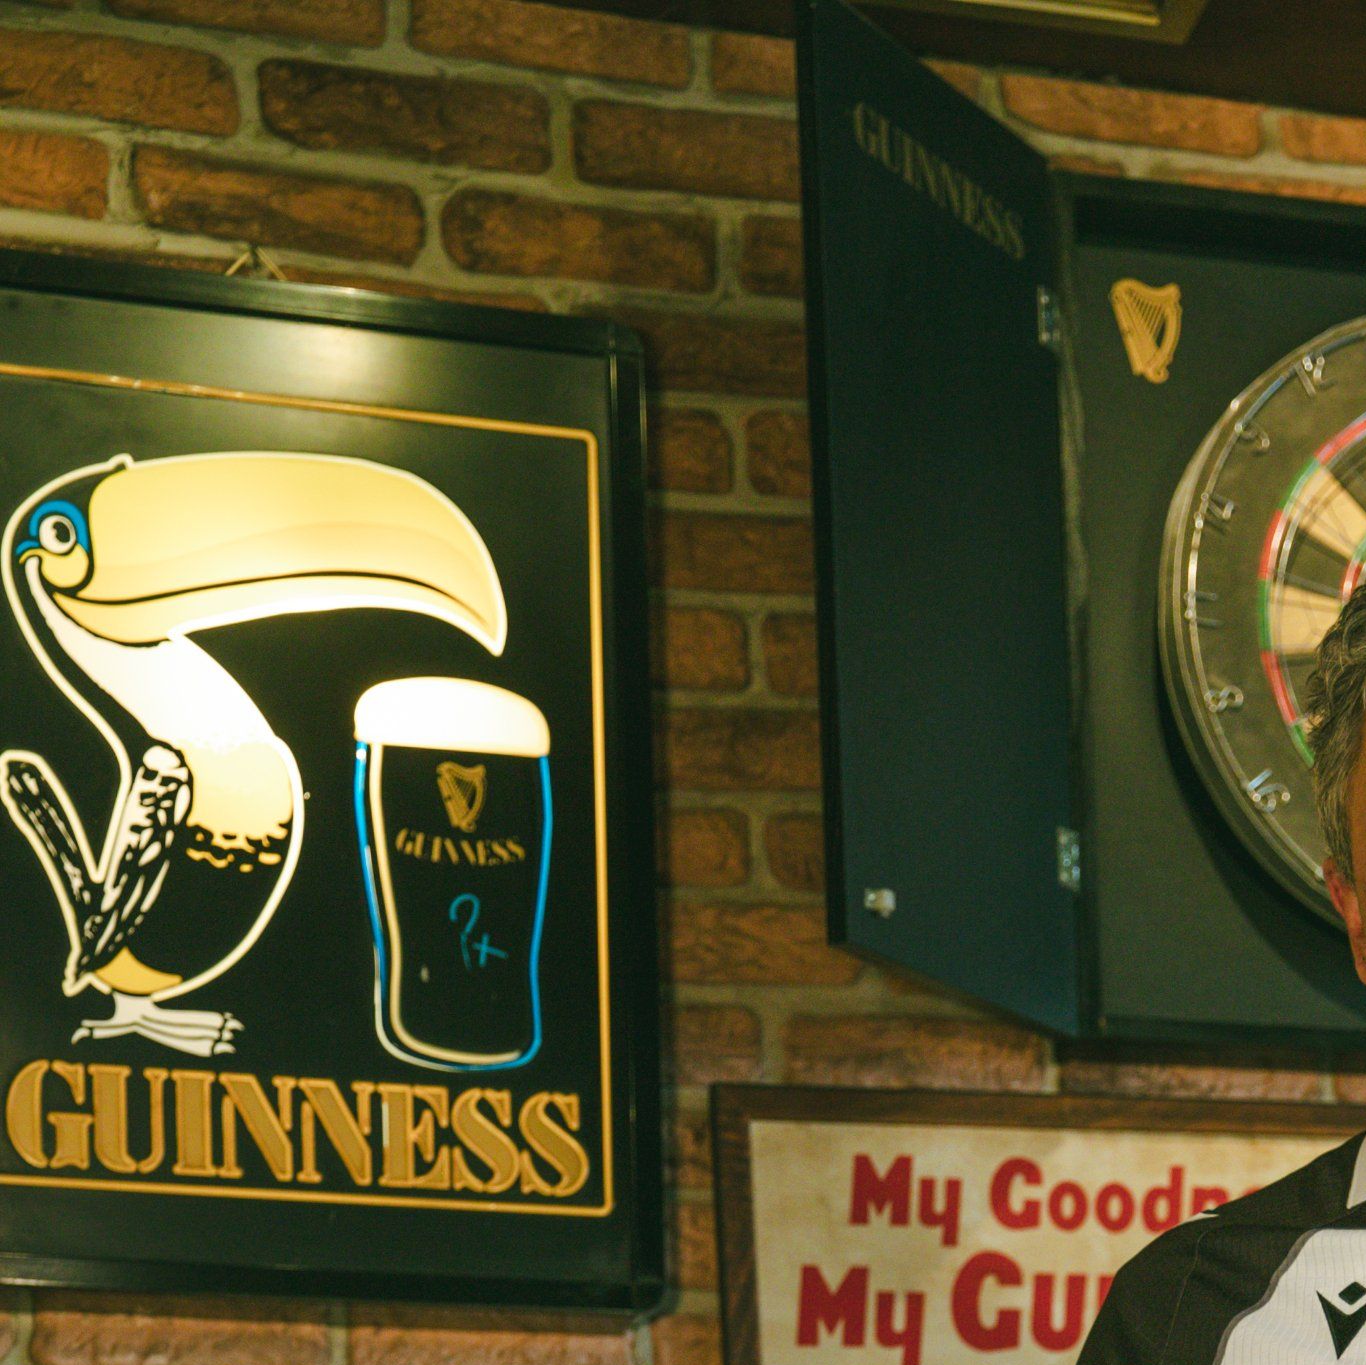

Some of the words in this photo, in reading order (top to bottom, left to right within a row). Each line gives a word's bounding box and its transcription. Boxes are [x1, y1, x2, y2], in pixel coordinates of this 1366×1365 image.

[395, 828, 527, 866] GUINNESS
[6, 1058, 590, 1198] GUINNESS
[849, 1153, 962, 1247] My
[988, 1156, 1266, 1233] Goodn
